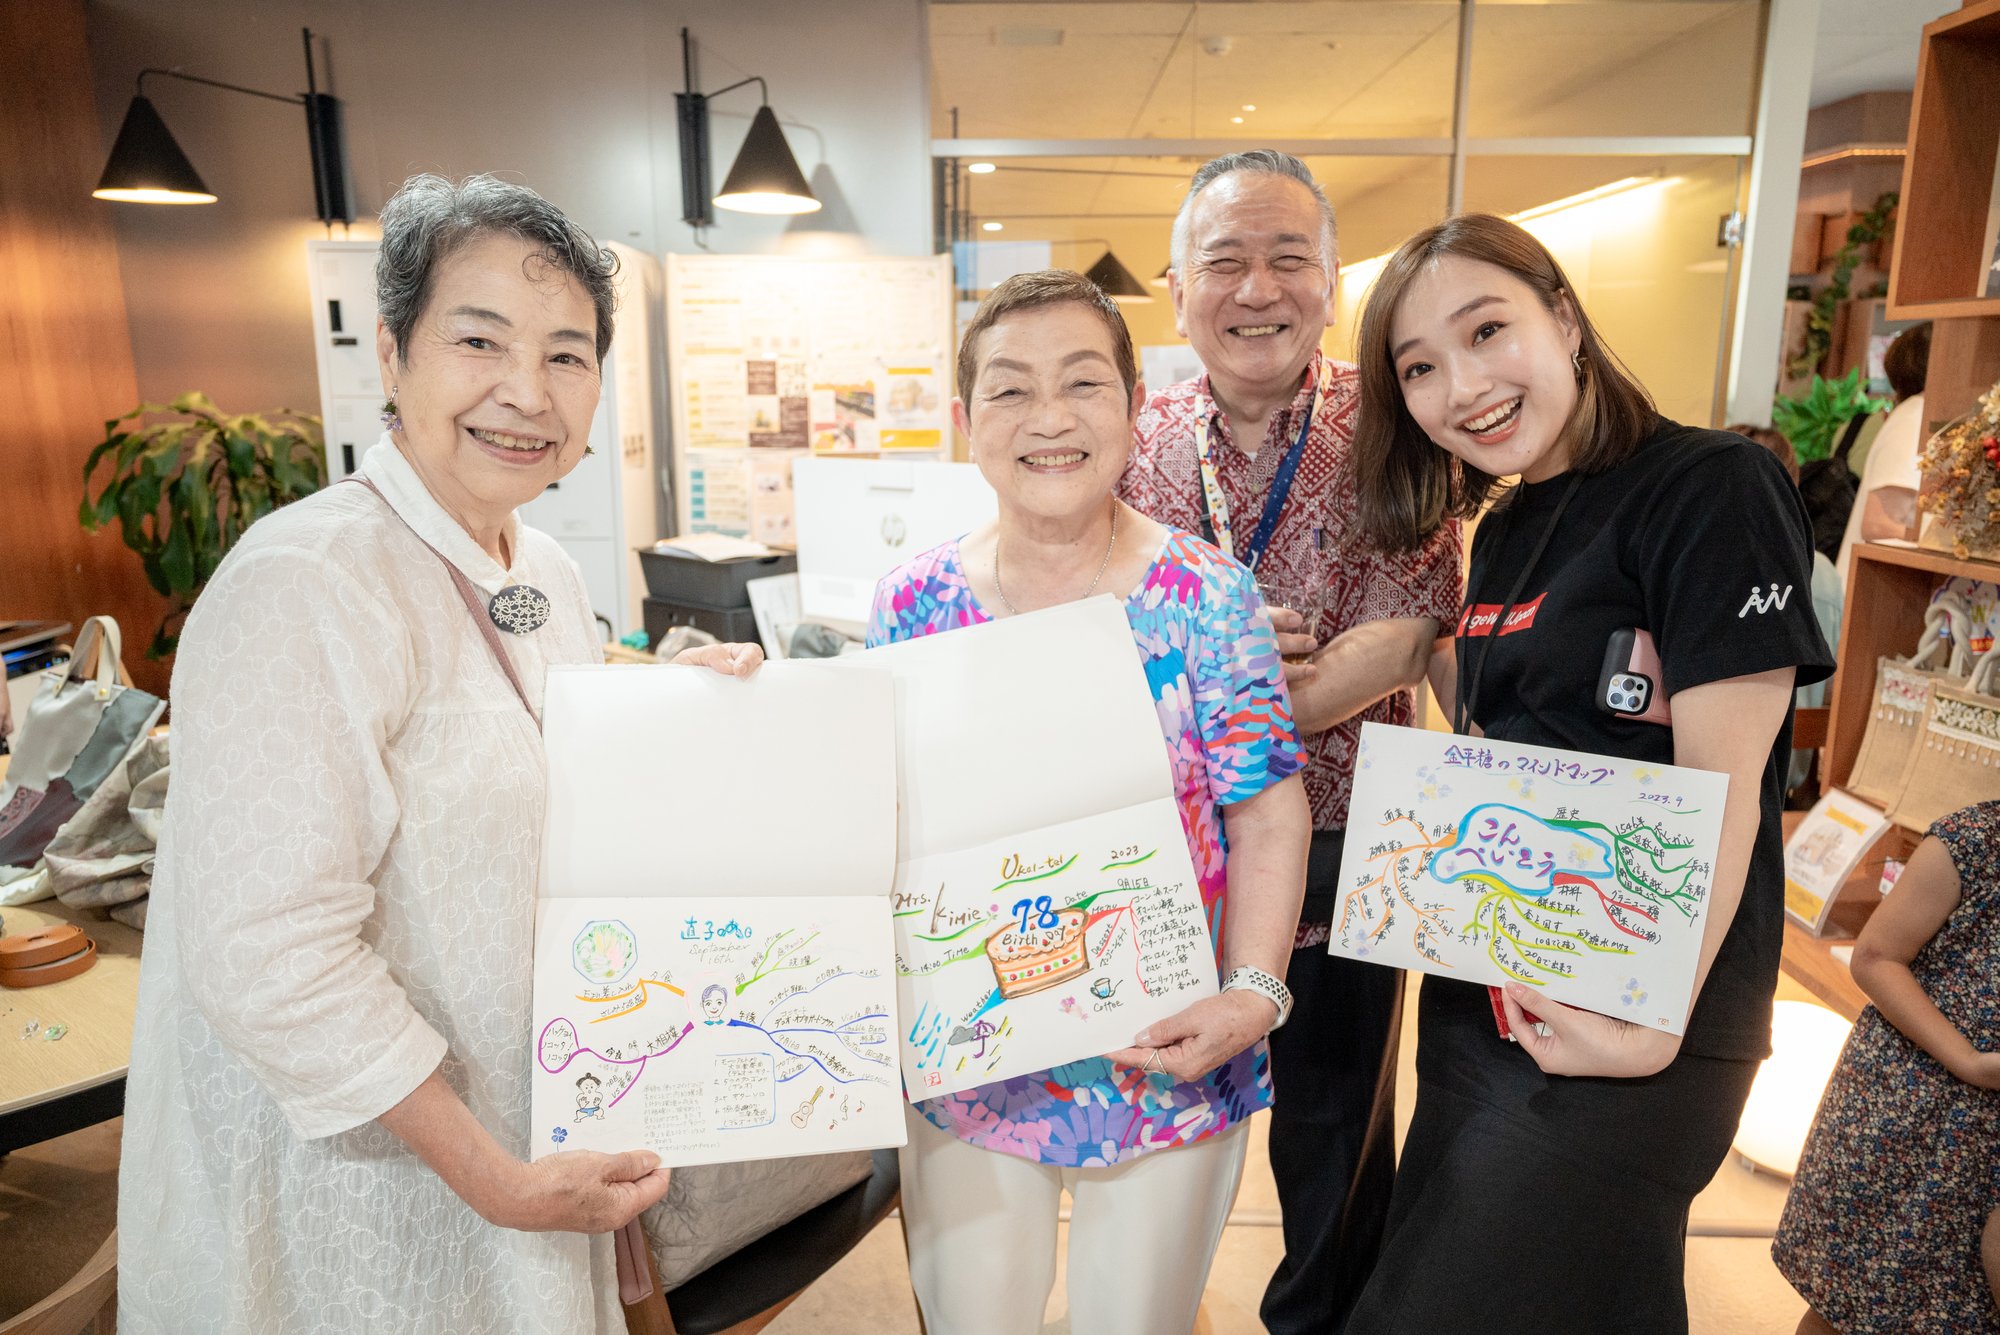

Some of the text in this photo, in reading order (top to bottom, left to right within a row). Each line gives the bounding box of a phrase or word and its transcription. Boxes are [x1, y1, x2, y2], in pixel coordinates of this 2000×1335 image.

[1556, 807, 1581, 821] 歴史
[1433, 823, 1457, 838] 用途
[1478, 817, 1521, 847] こん
[1616, 816, 1645, 836] 1546年
[1110, 845, 1139, 860] 2023
[895, 893, 931, 910] Mrs.
[1064, 890, 1088, 906] Date
[1685, 882, 1706, 903] 京都
[1012, 895, 1059, 933] 78
[1001, 925, 1067, 946] Birth Day
[689, 943, 751, 962] September
[1093, 998, 1124, 1013] Coffee
[647, 1025, 680, 1055] 大相撲
